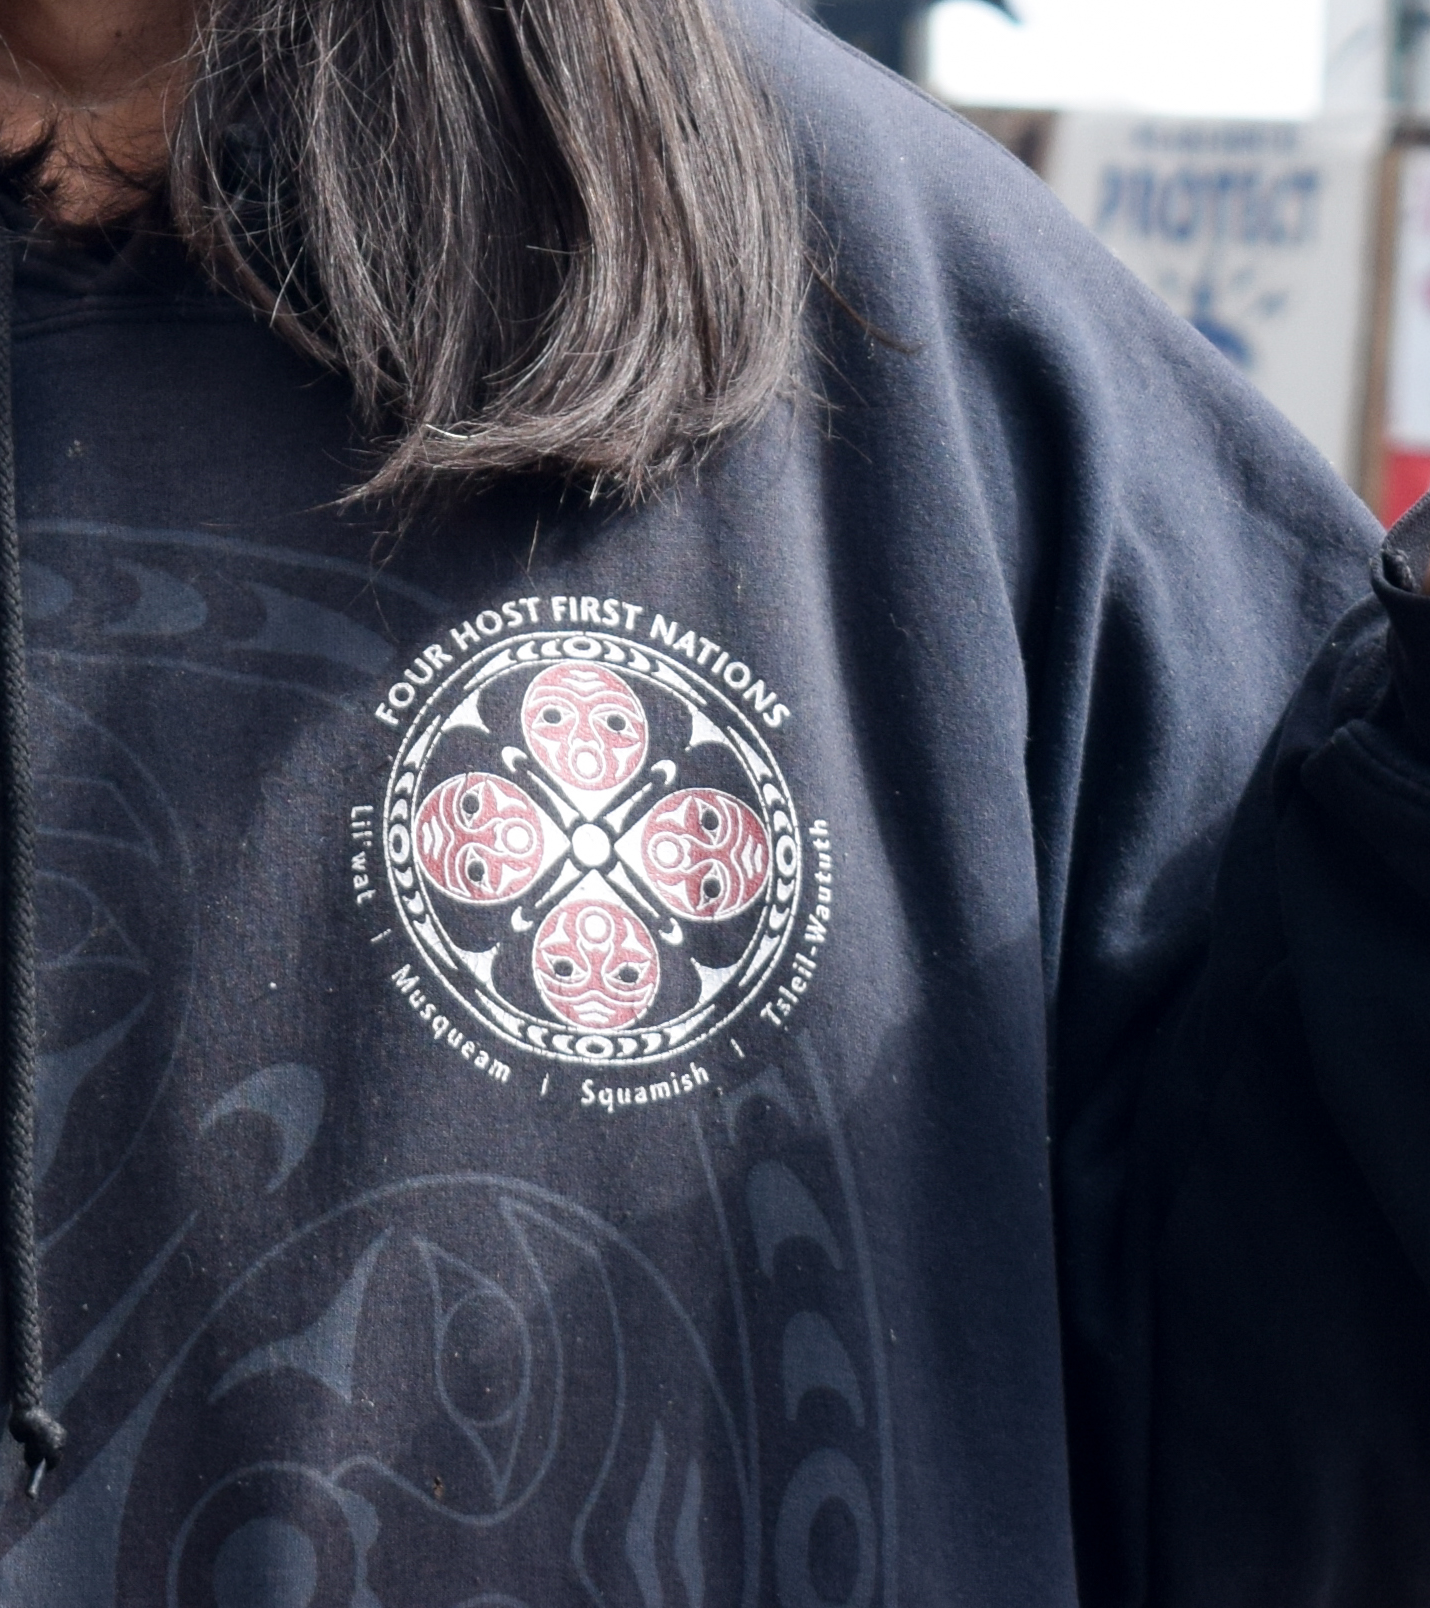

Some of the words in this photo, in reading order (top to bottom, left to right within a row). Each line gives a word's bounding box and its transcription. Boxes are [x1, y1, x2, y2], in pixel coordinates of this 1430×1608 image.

[374, 644, 452, 728] FOUR
[450, 596, 540, 651] HOST
[551, 595, 643, 631] FIRST
[649, 613, 790, 729] NATIONS
[391, 963, 512, 1083] Musqueam
[580, 1063, 710, 1113] Squamish
[760, 817, 832, 1029] Tsleil-Waututh
